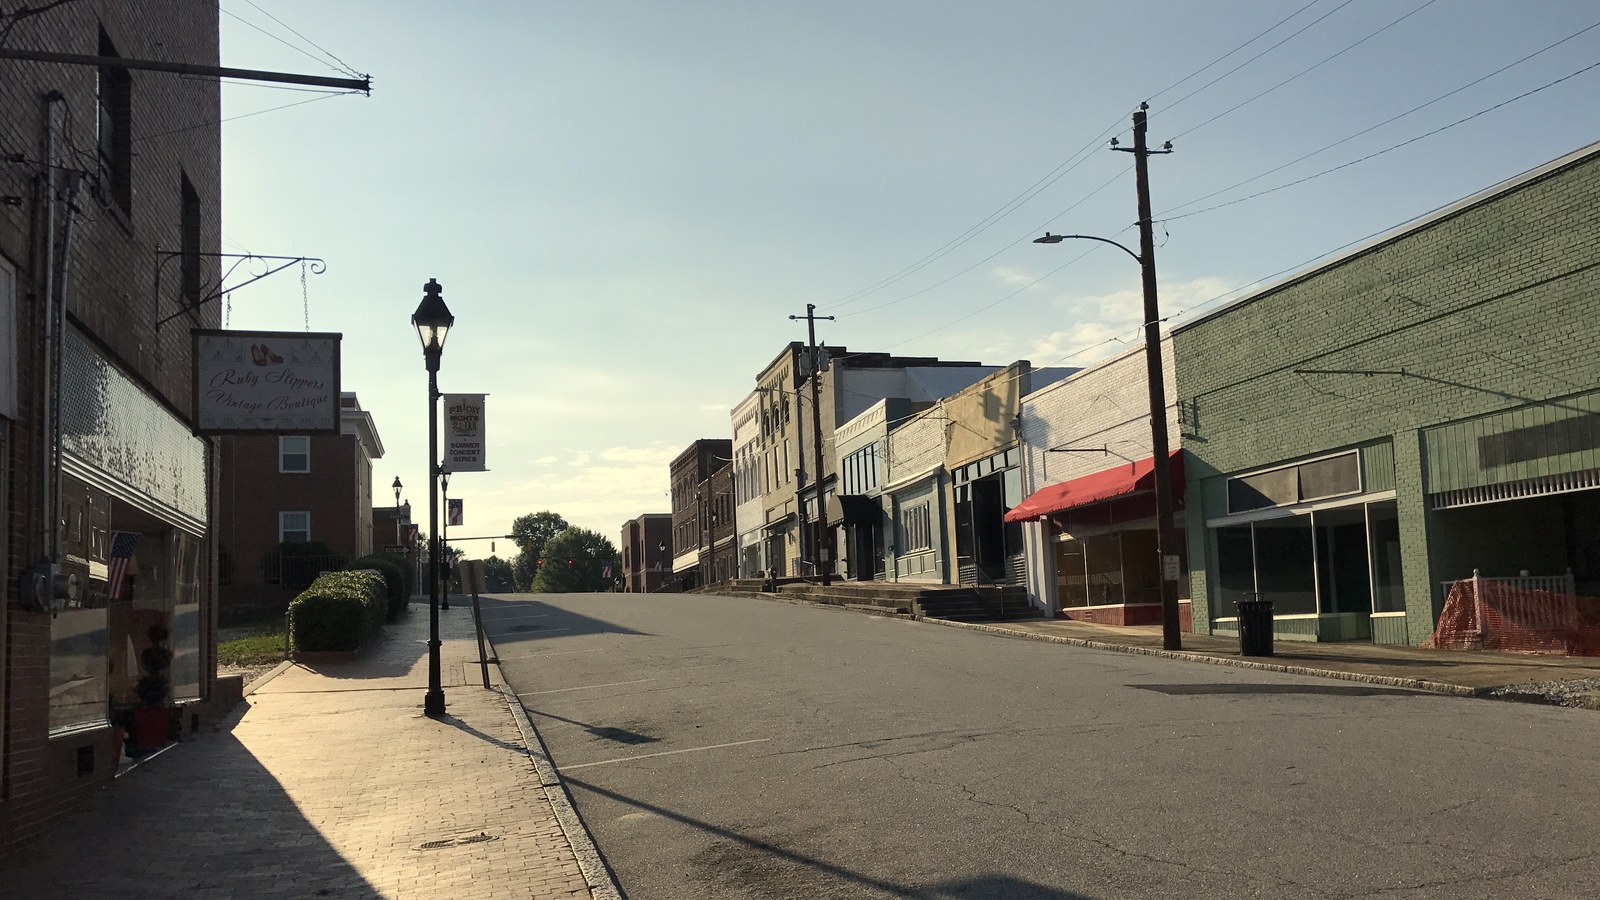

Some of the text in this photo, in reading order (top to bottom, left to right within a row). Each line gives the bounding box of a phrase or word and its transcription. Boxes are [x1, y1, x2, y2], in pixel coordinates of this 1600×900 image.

[210, 367, 325, 390] Ruby Slippers
[207, 389, 328, 413] Vintage Boutique
